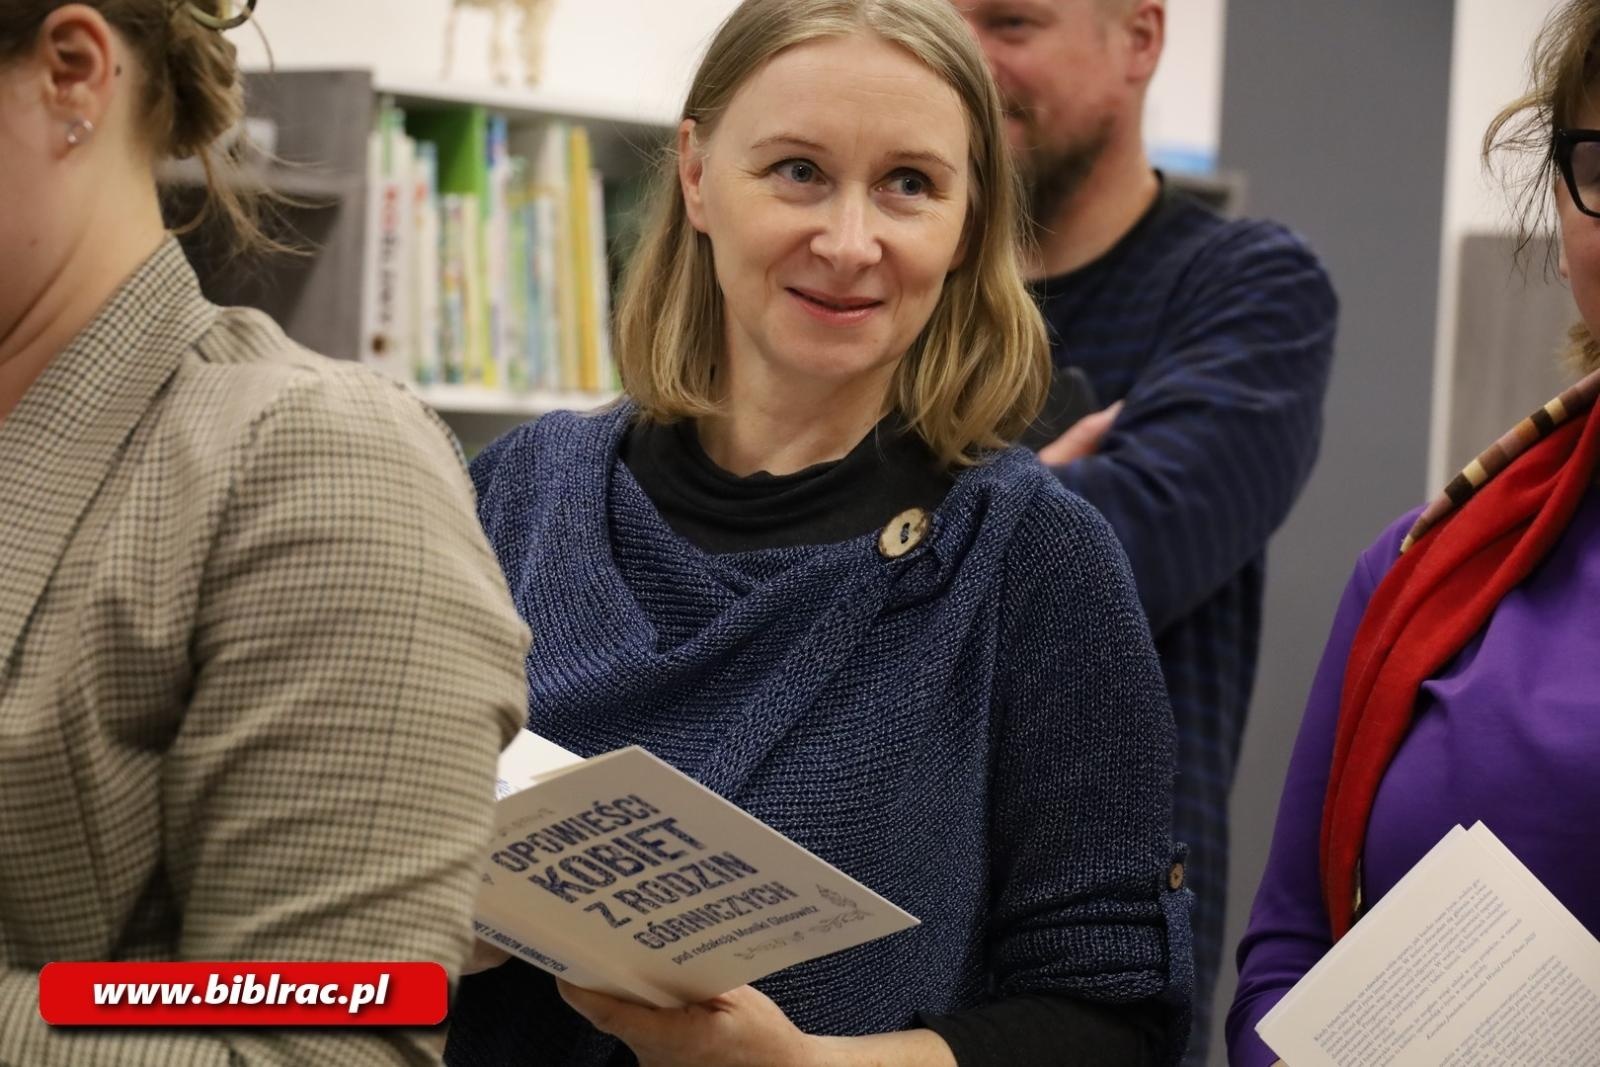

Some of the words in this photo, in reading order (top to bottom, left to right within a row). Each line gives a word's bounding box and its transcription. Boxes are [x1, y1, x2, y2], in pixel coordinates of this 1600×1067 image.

[491, 794, 660, 873] OPOWIEŚCI
[528, 817, 705, 903] KOBIET
[583, 901, 633, 928] Z
[612, 851, 759, 915] RODZIN
[633, 881, 799, 950] GÓRNICZYCH
[672, 953, 694, 965] pod
